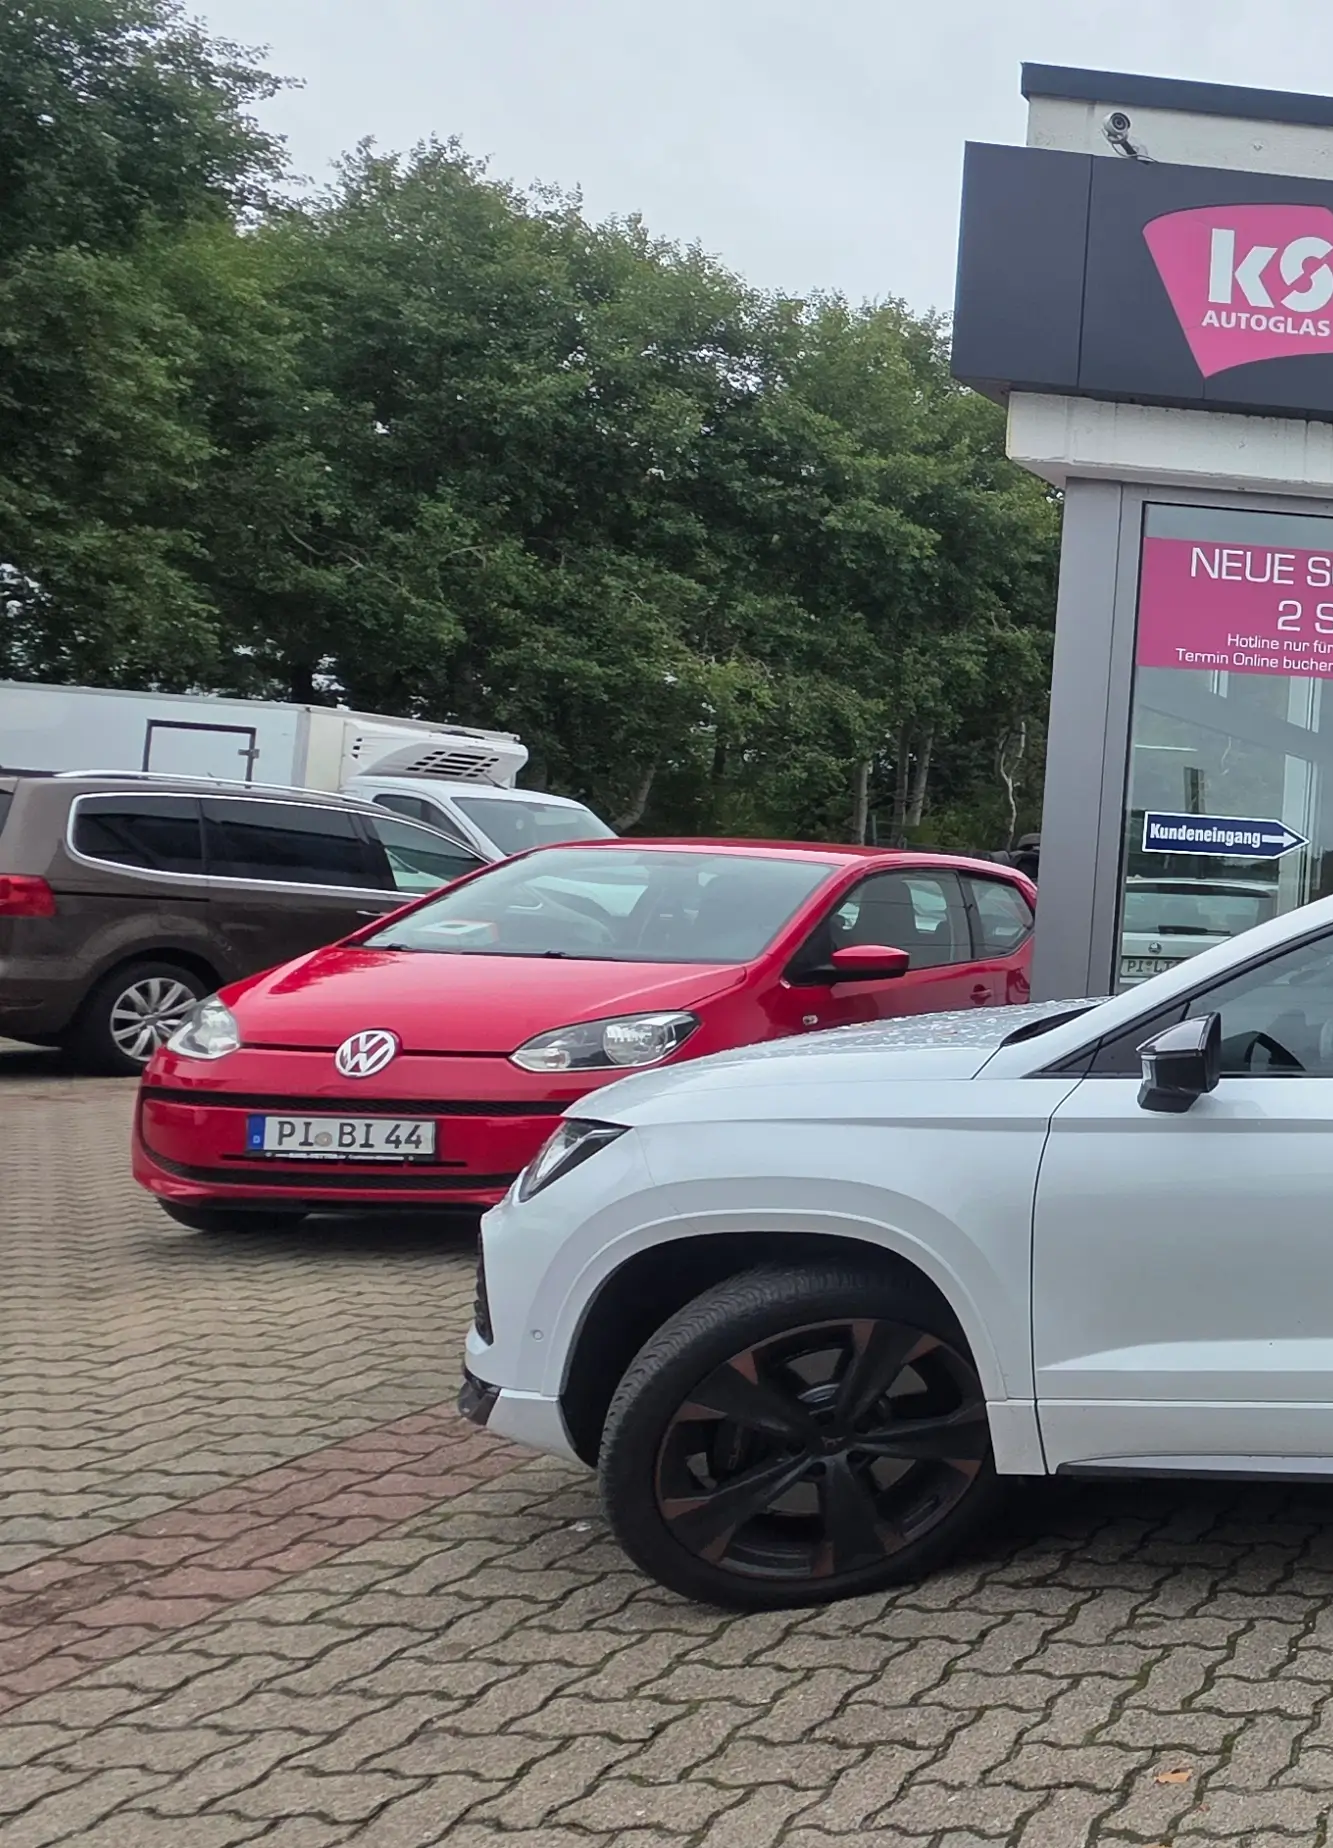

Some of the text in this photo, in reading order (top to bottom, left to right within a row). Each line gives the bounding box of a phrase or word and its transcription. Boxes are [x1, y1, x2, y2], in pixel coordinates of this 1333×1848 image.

[1201, 310, 1331, 337] AUTOGLAS
[1191, 547, 1295, 585] NEUE
[1277, 600, 1303, 631] 2
[1227, 633, 1280, 649] Hotline
[1283, 640, 1310, 652] nur
[1176, 648, 1229, 664] Termin
[1233, 652, 1279, 668] Online
[1149, 823, 1263, 849] Kundeneingang
[1127, 960, 1144, 973] PI
[277, 1120, 315, 1147] PI
[337, 1122, 375, 1149] BI
[384, 1123, 423, 1150] 44
